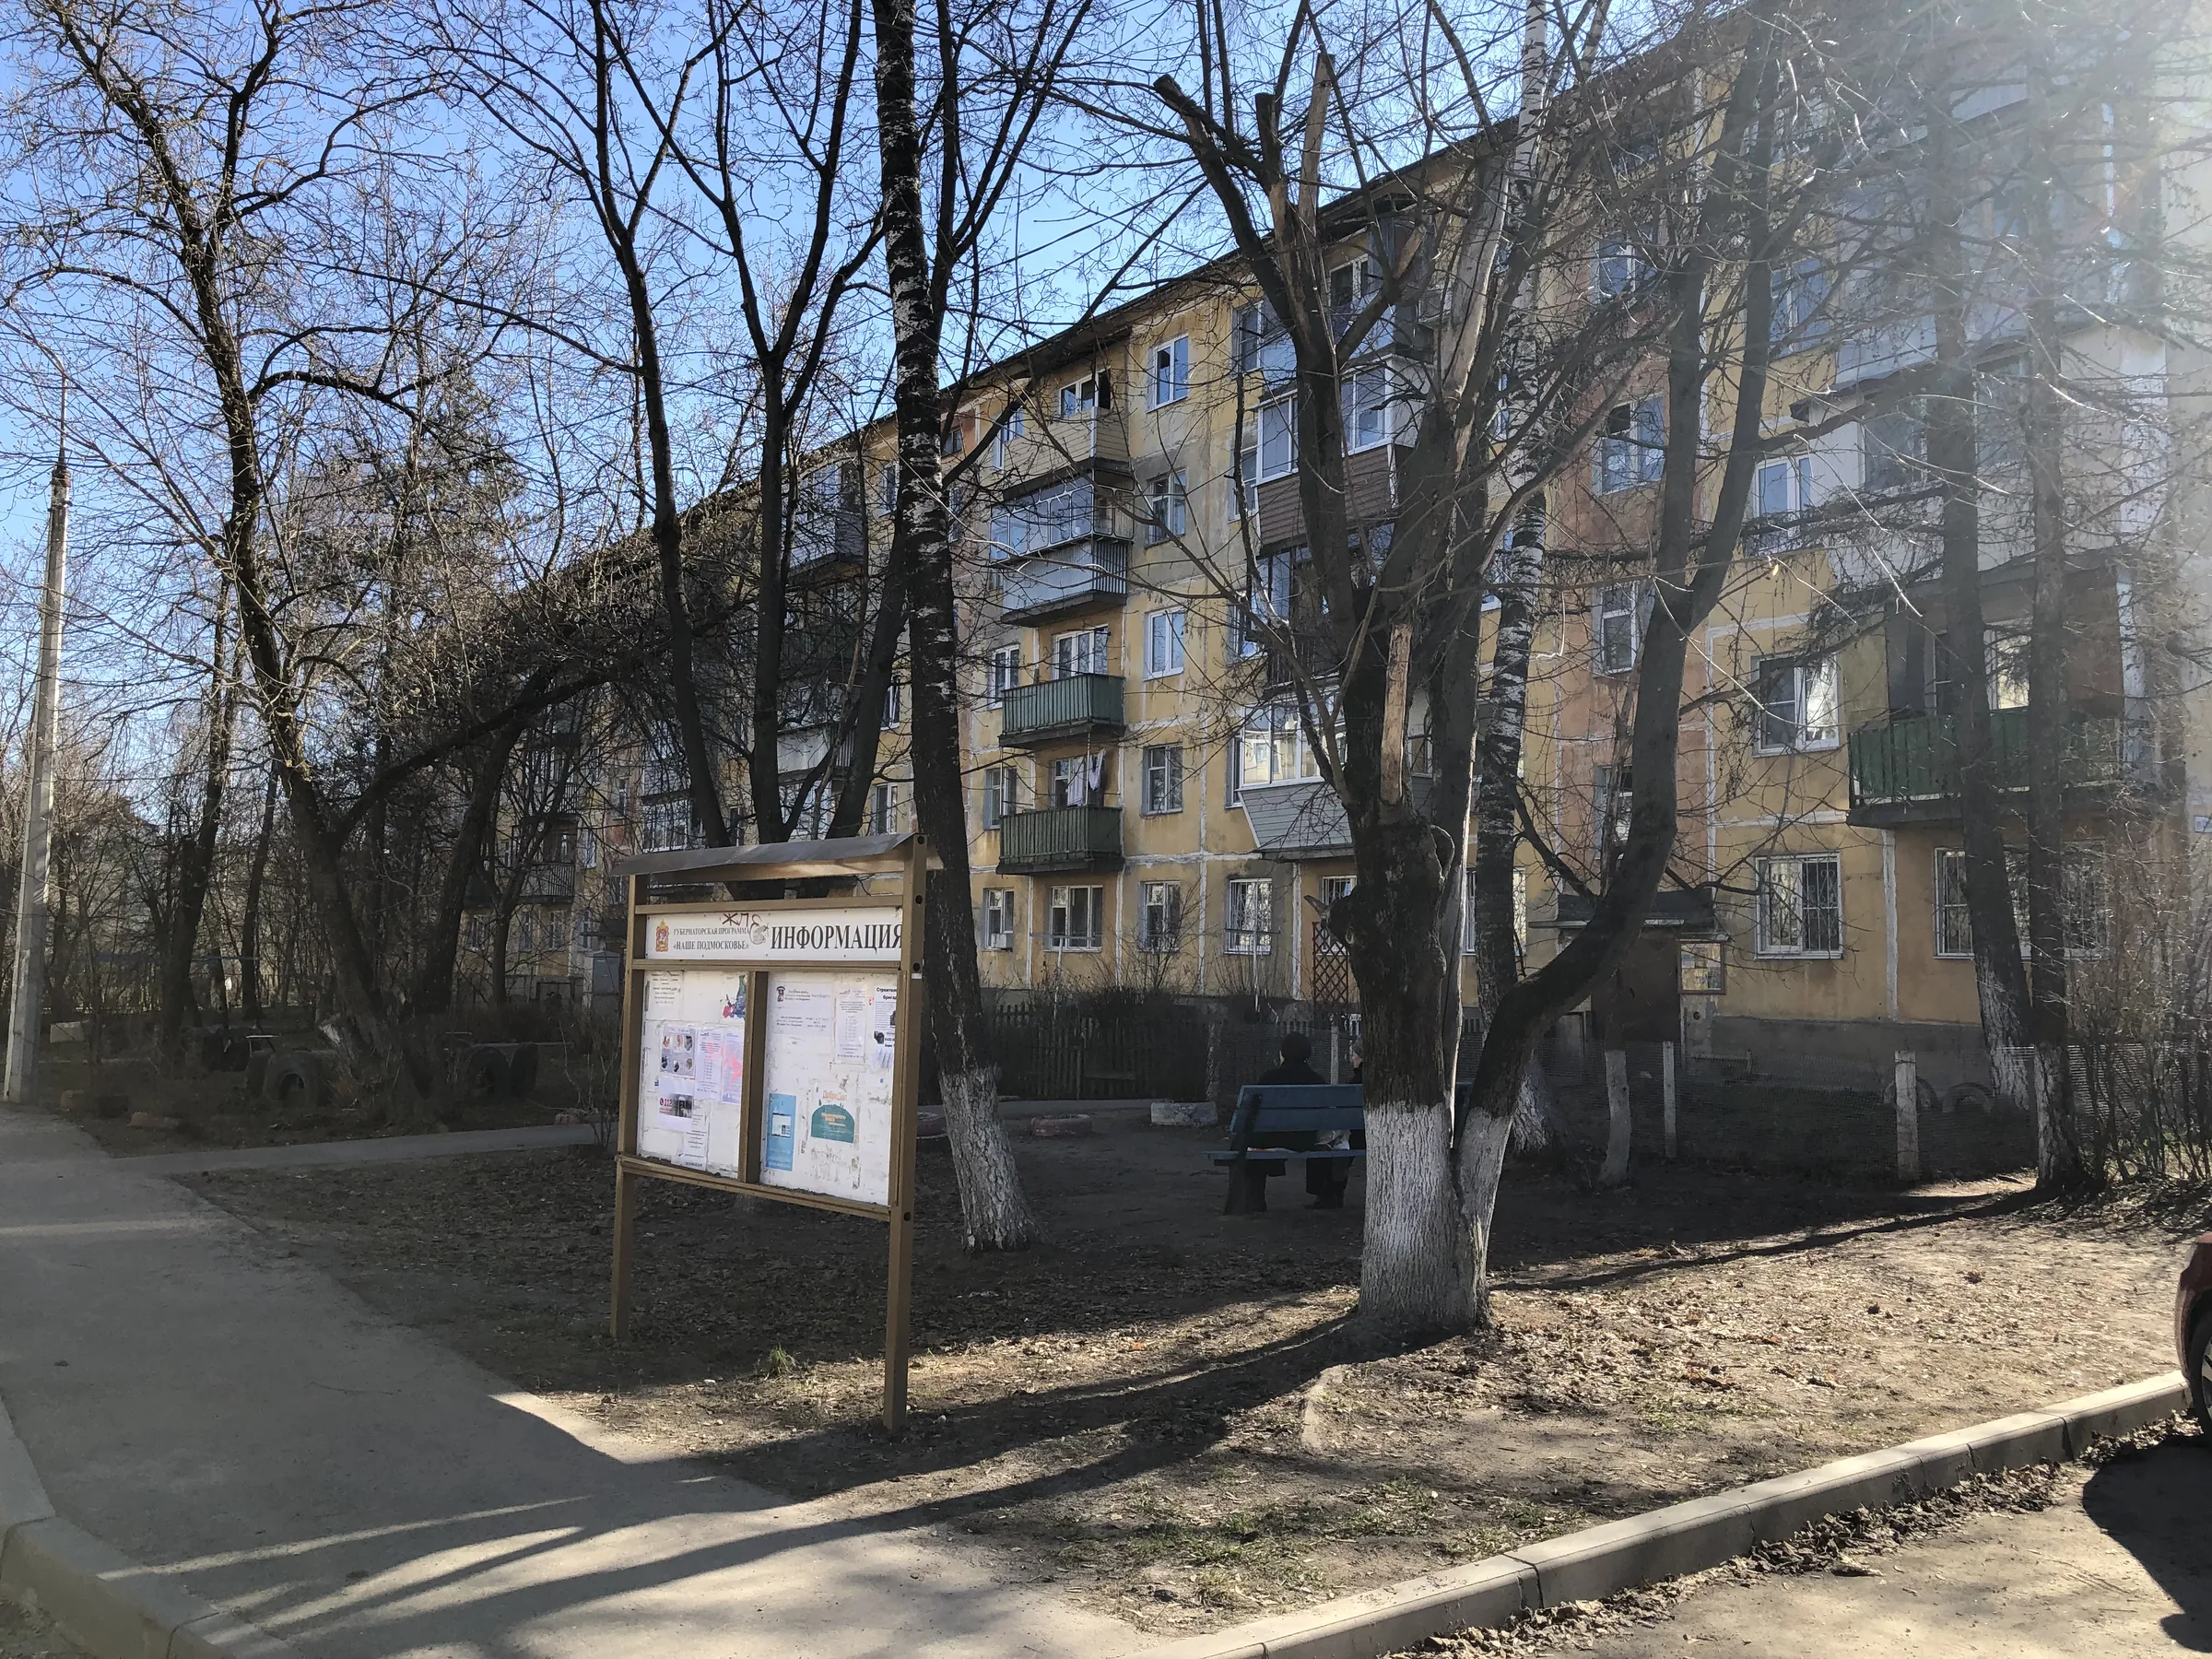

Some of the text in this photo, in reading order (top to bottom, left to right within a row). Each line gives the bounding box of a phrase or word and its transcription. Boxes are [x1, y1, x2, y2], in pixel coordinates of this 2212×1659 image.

[673, 926, 751, 935] ГУБЕРНАТОРСКАЯ ПРОГРАММА
[771, 924, 902, 955] ИНФОРМАЦИЯ
[673, 940, 750, 951] «НАШЕ ПОДМОСКОВЬЕ»
[664, 1098, 673, 1107] 112
